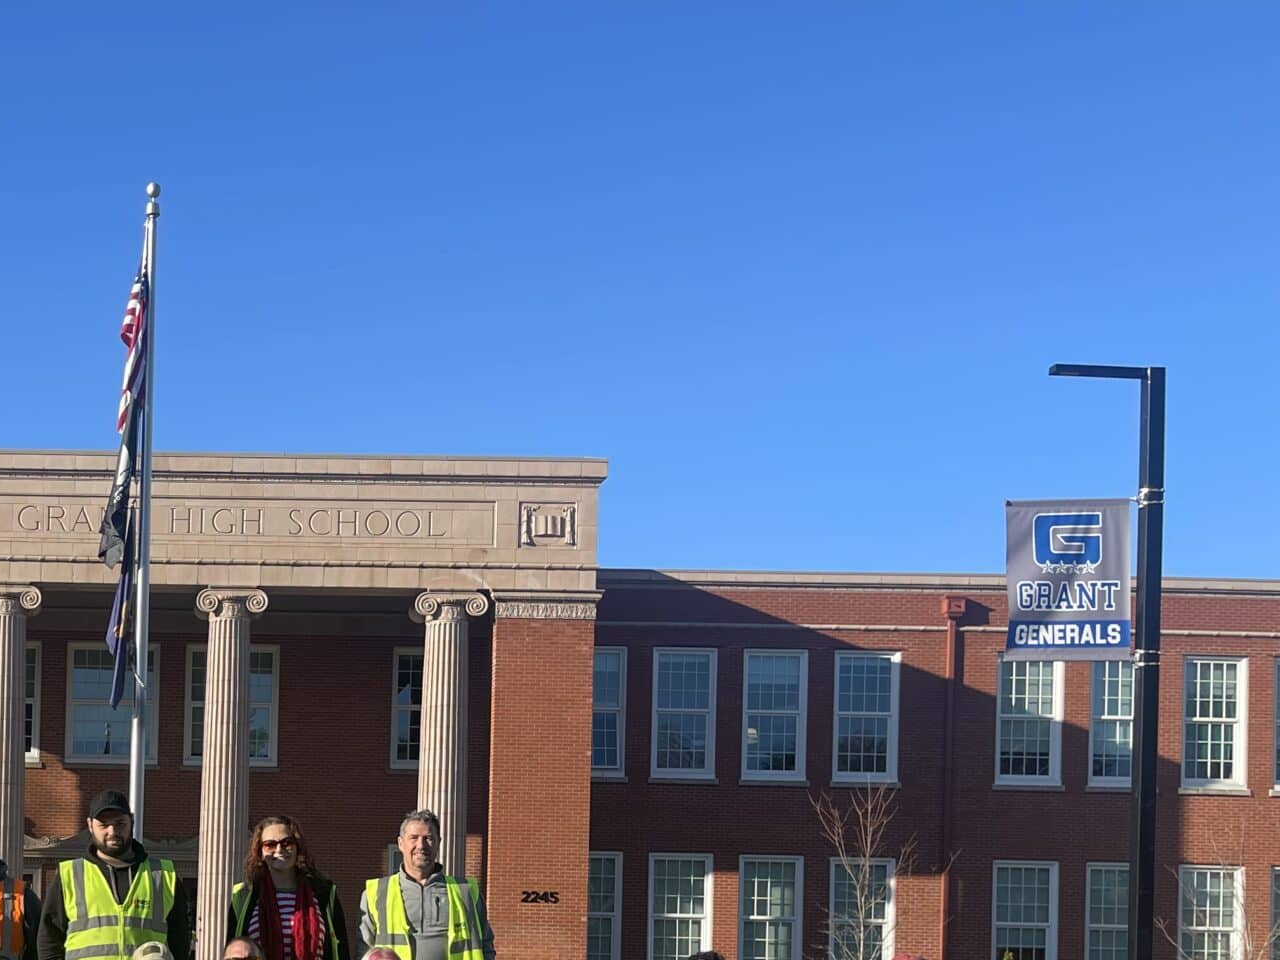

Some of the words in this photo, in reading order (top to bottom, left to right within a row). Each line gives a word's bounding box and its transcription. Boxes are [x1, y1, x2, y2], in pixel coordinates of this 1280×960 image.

[17, 504, 106, 533] GRA
[169, 507, 264, 536] HIGH
[288, 508, 447, 537] SCHOOL
[1017, 580, 1120, 611] GRANT
[1015, 624, 1121, 645] GENERALS
[521, 890, 560, 904] 2245
